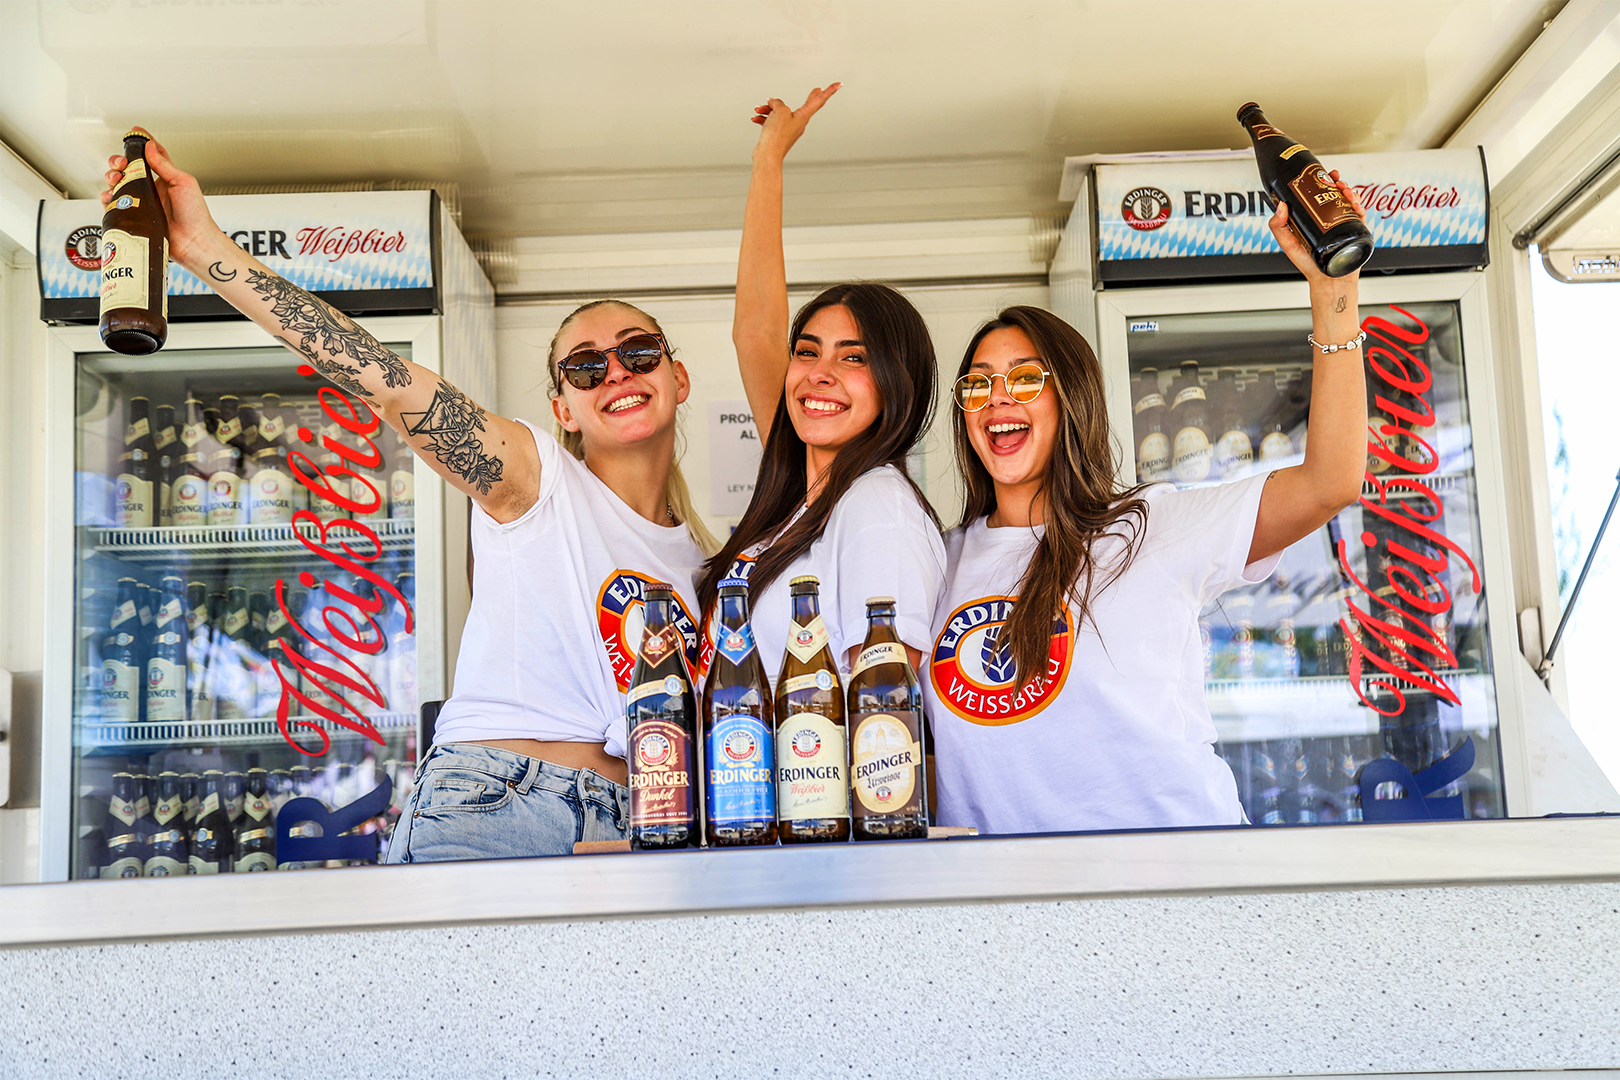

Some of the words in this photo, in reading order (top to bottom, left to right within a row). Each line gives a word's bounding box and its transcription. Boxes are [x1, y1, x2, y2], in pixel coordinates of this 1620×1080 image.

[1124, 189, 1168, 207] ERDINGER
[1183, 190, 1278, 222] ERDIN
[68, 227, 103, 246] ERDING
[295, 225, 408, 263] Weißbier
[727, 484, 745, 493] LEY
[271, 363, 414, 757] Weißbie
[938, 602, 1016, 650] ERDIN
[780, 765, 841, 782] ERDINGER
[856, 751, 913, 779] ERDINGER
[630, 770, 690, 790] ERDINGER
[710, 767, 773, 785] ERDINGER
[639, 787, 676, 802] Dunkel
[789, 783, 827, 797] Weißbier
